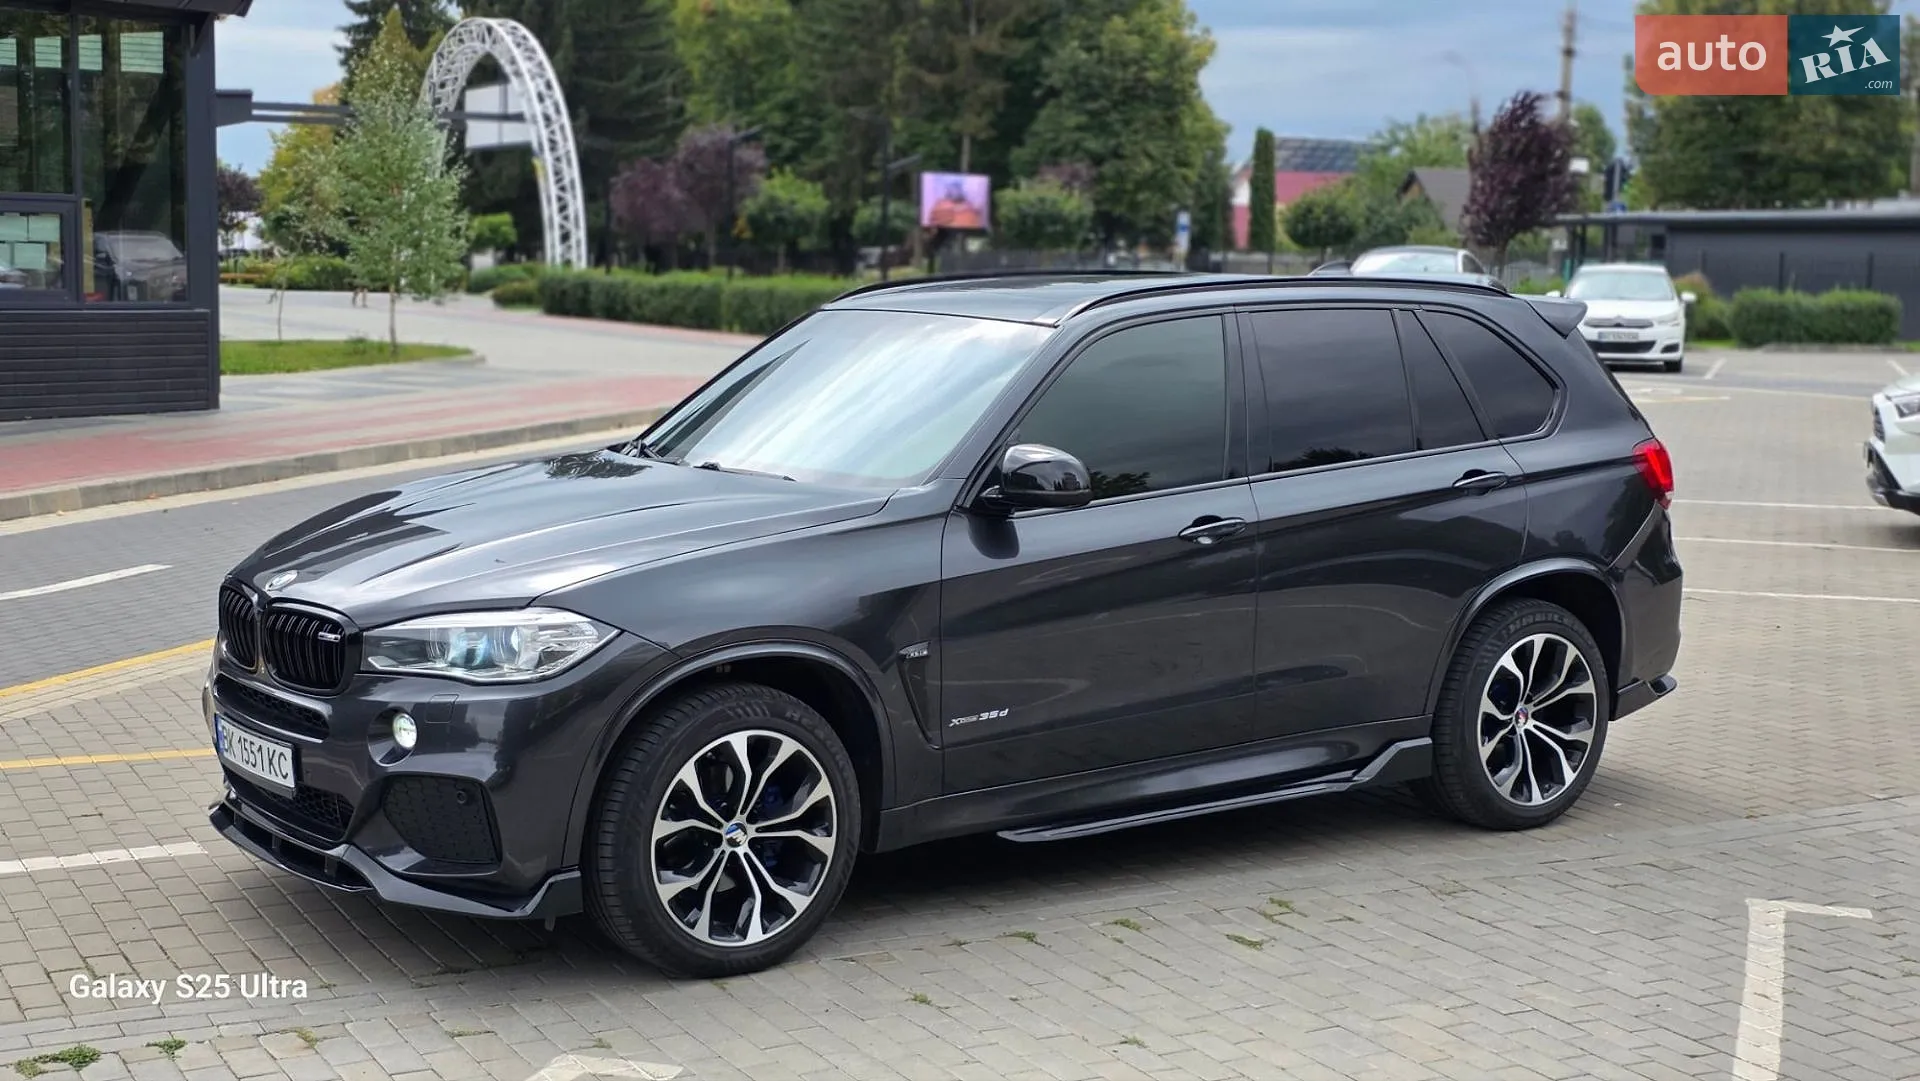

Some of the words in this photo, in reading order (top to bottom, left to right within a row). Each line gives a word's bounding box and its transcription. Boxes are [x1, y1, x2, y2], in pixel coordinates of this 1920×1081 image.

[221, 725, 236, 759] BK
[238, 735, 265, 773] 1551
[267, 746, 289, 780] KC
